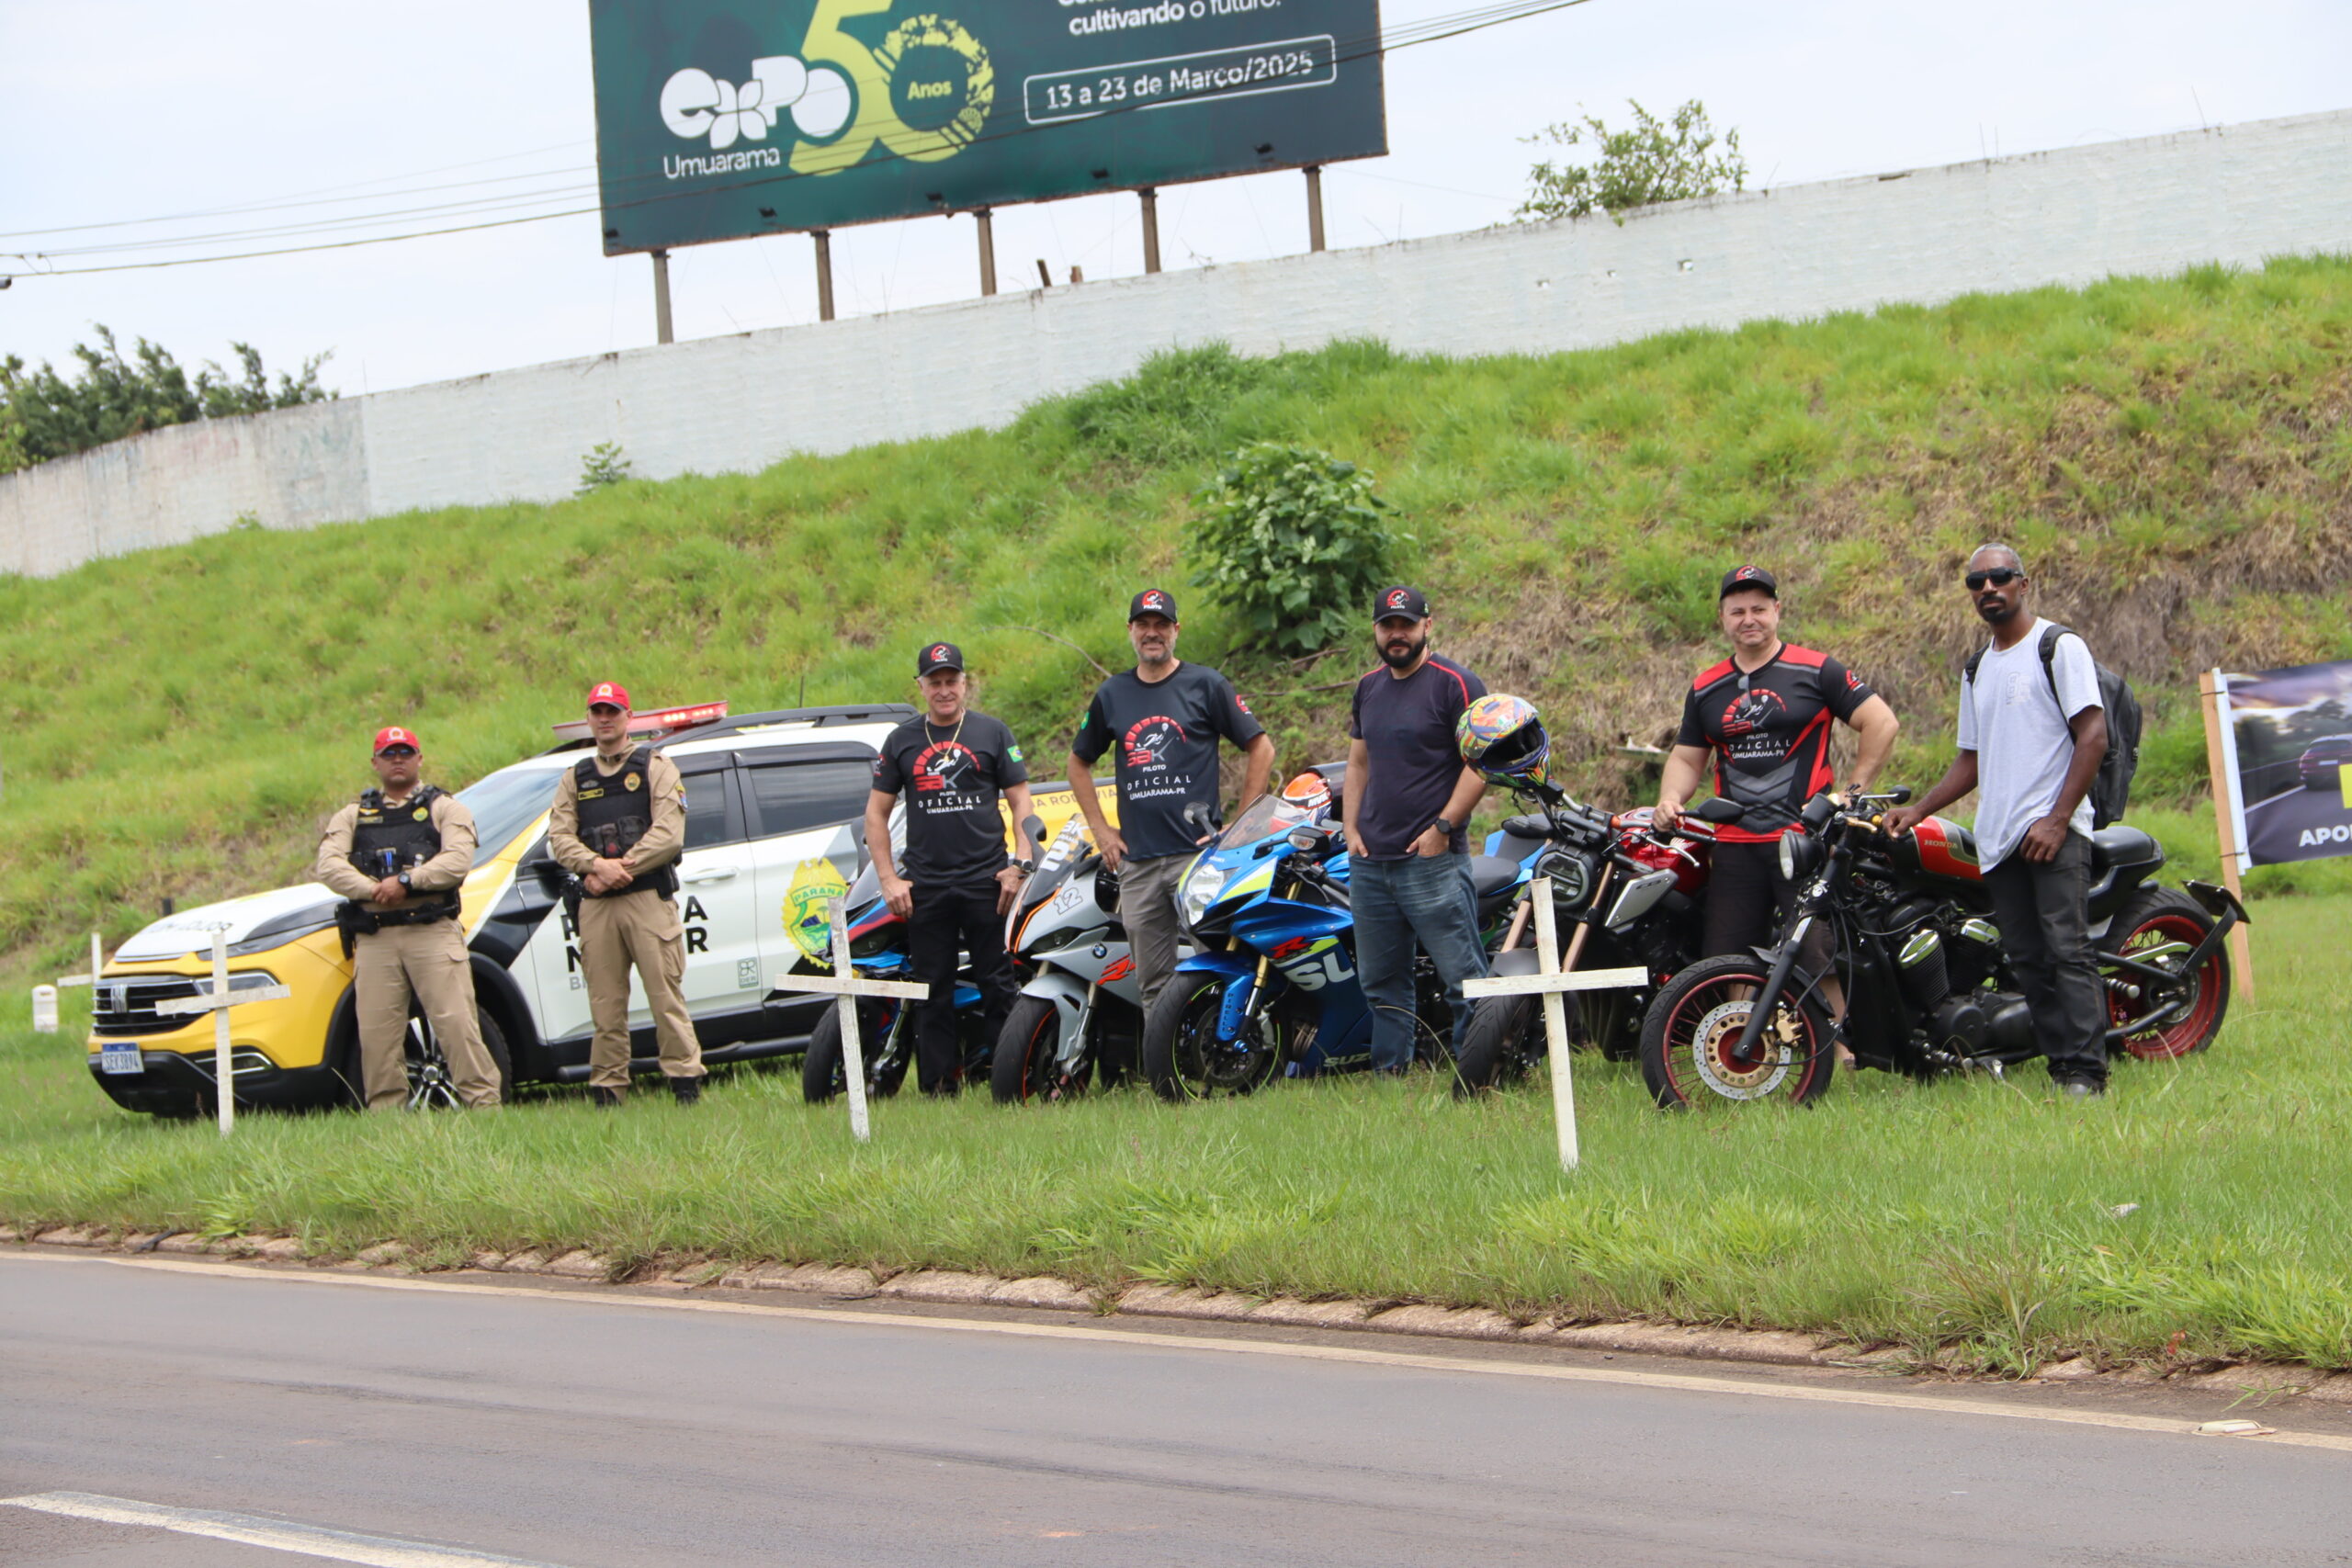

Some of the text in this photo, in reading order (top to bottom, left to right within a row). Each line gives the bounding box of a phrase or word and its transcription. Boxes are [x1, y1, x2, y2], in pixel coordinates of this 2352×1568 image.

[1069, 2, 1185, 36] cultivando
[1189, 1, 1205, 18] o
[907, 80, 952, 100] Anos
[1046, 51, 1314, 109] 13 a 23 de Março/2025
[663, 147, 780, 179] Umuarama
[1142, 764, 1167, 773] PILOTO
[1127, 774, 1191, 791] OFICIAL
[919, 795, 981, 808] OFICIAL
[1129, 787, 1186, 800] UMUARAMA-PR
[1923, 839, 1959, 849] HONDA
[2299, 825, 2352, 847] APO
[1054, 887, 1083, 916] 12
